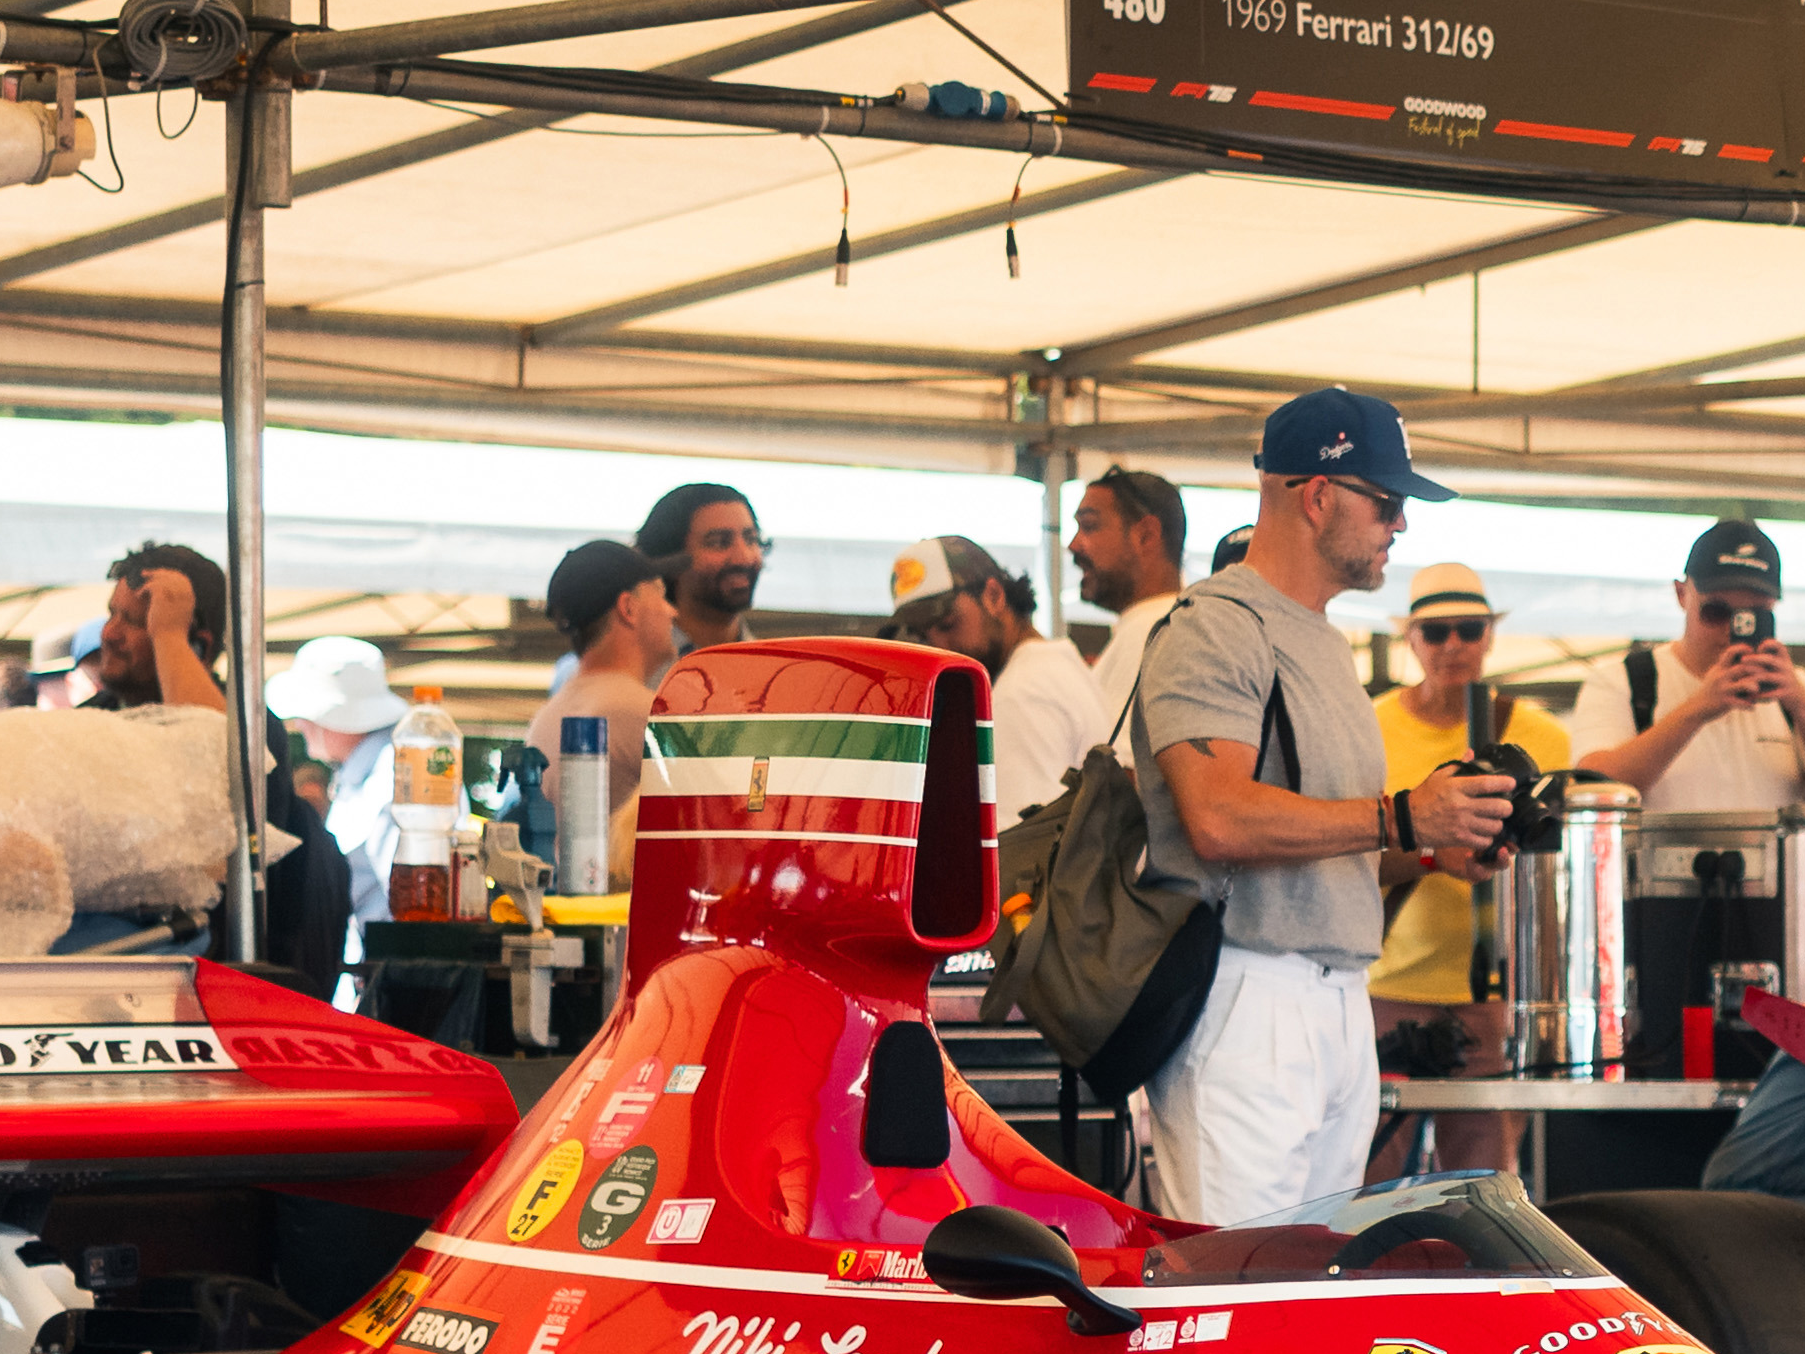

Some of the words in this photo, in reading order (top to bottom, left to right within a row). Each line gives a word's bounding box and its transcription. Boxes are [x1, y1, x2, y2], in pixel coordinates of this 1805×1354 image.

[1297, 1, 1392, 49] Ferrari
[1402, 15, 1494, 60] 312/69
[1404, 96, 1487, 121] GOODWOOD
[598, 1092, 656, 1123] F
[527, 1180, 558, 1211] F
[591, 1181, 646, 1216] G
[511, 1214, 539, 1236] 27
[596, 1215, 613, 1236] 3
